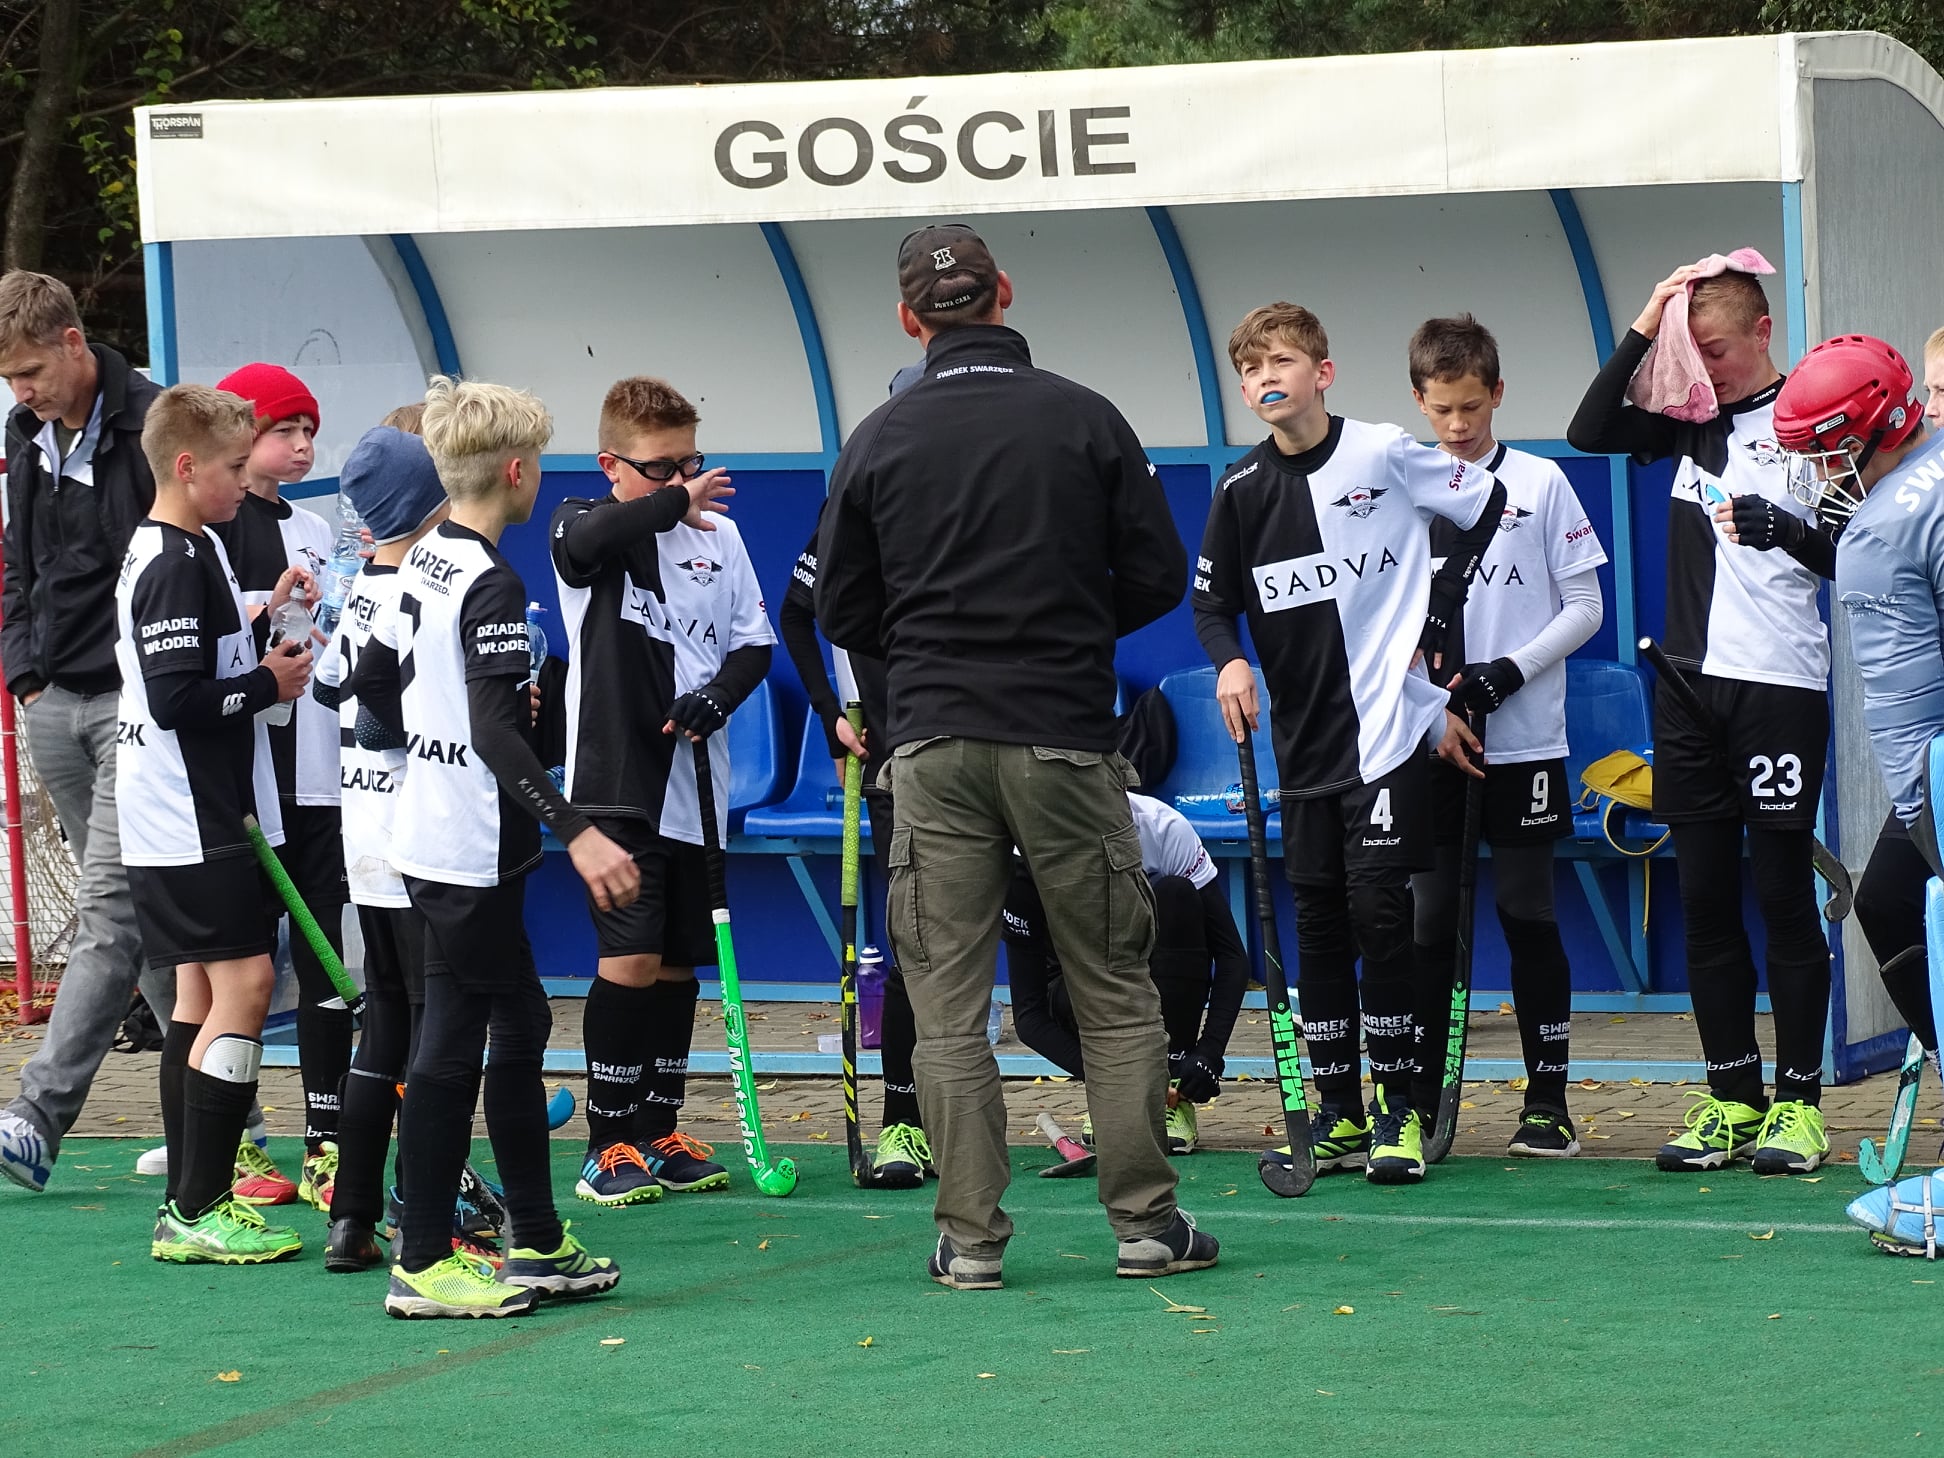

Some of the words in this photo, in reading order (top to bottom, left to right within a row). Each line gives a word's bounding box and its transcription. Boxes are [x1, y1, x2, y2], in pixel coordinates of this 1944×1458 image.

[714, 95, 1136, 189] GOŚCIE
[936, 366, 969, 379] SWAREK
[1265, 546, 1399, 600] SADVA
[141, 617, 199, 639] DZIADEK
[143, 635, 200, 656] WŁODEK
[476, 639, 531, 655] WŁODEK
[1531, 770, 1549, 814] 9
[1749, 753, 1803, 797] 23
[1370, 788, 1394, 832] 4
[1271, 1008, 1307, 1112] MALIK
[728, 1046, 758, 1169] Matador
